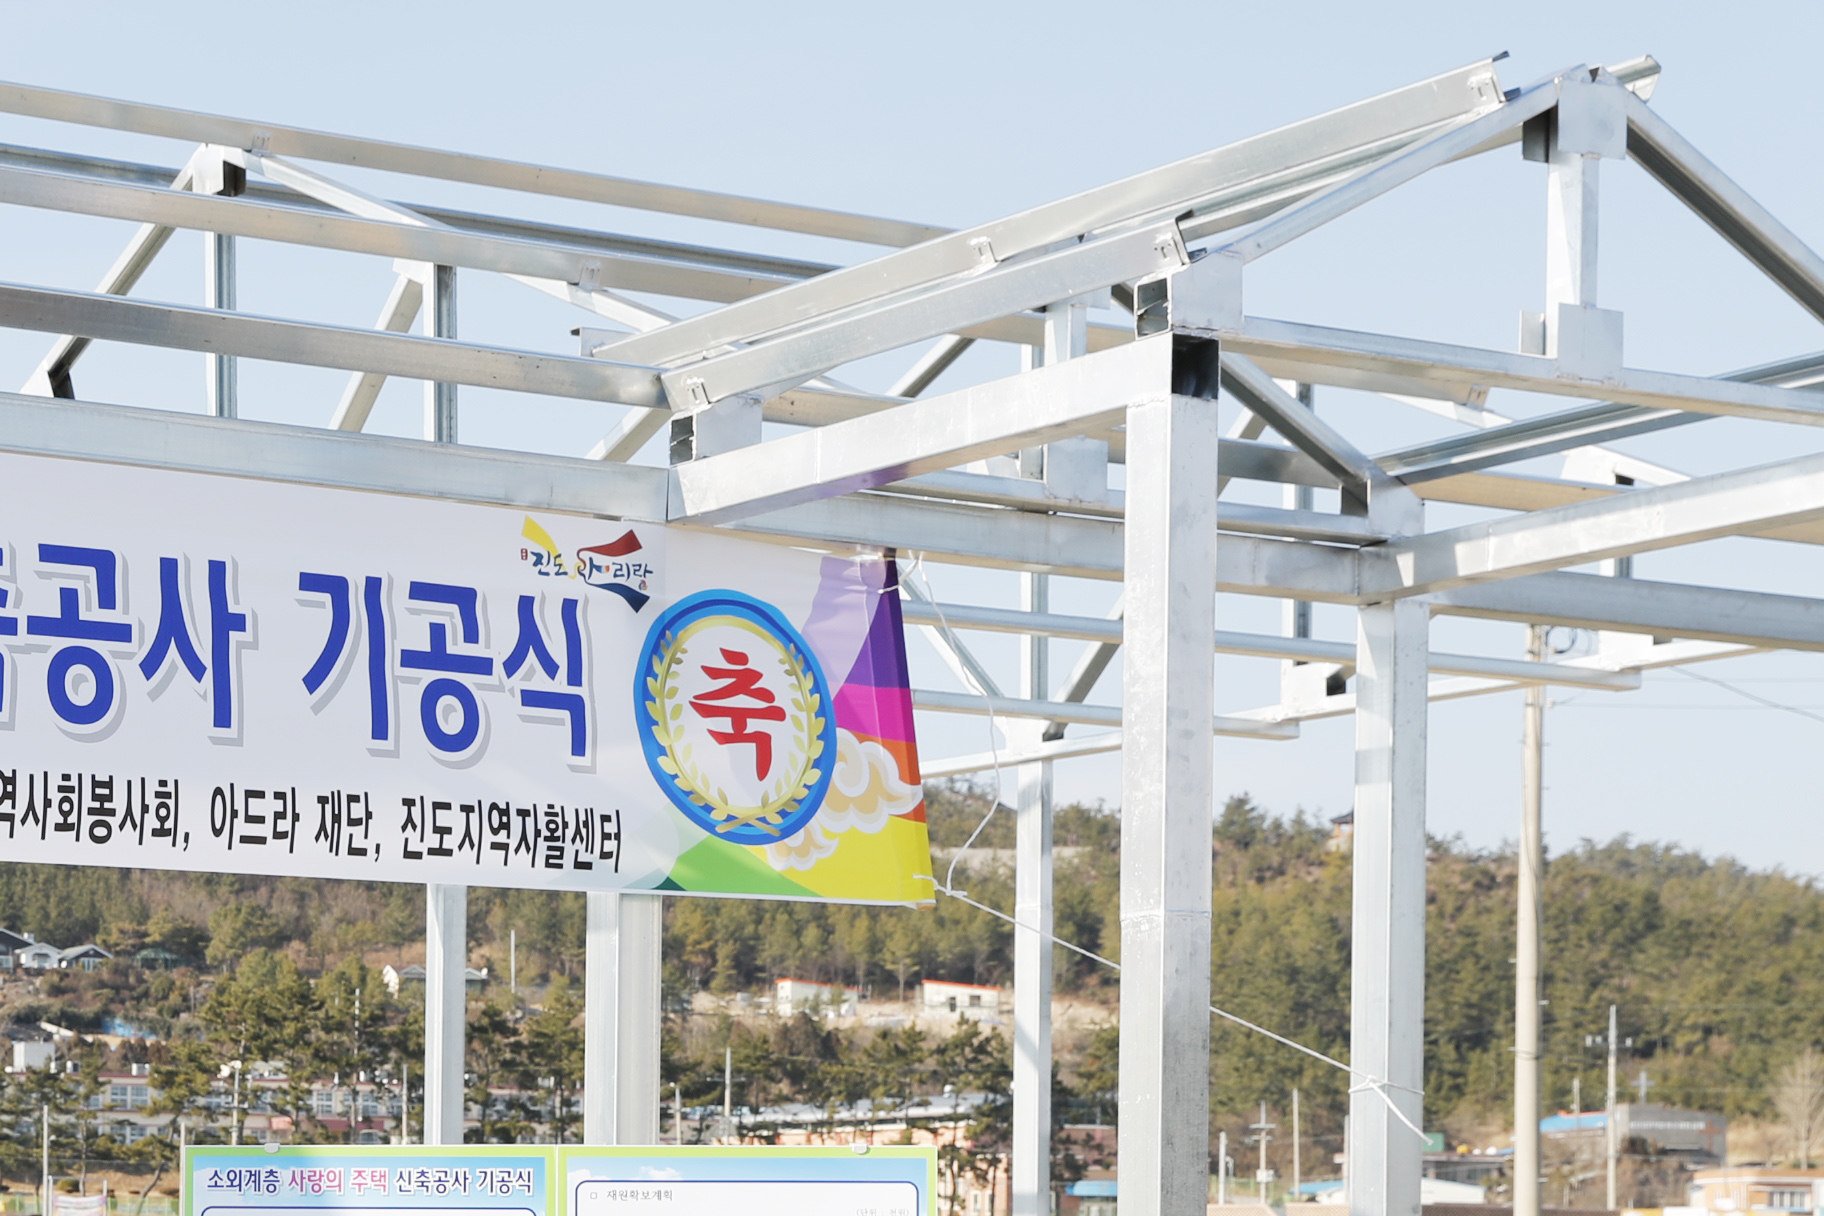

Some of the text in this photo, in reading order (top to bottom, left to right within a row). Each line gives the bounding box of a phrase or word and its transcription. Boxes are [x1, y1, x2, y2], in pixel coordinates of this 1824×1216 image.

[530, 551, 568, 576] 진도
[299, 572, 586, 756] 기공식
[689, 648, 785, 781] 축
[211, 783, 300, 853] 아드라
[315, 791, 381, 862] 재단,
[401, 796, 621, 873] 진도지역자활센터
[208, 1168, 534, 1195] 소외계층 사랑의 주택 신축공사 기공식
[606, 1190, 673, 1202] 재원확보계획
